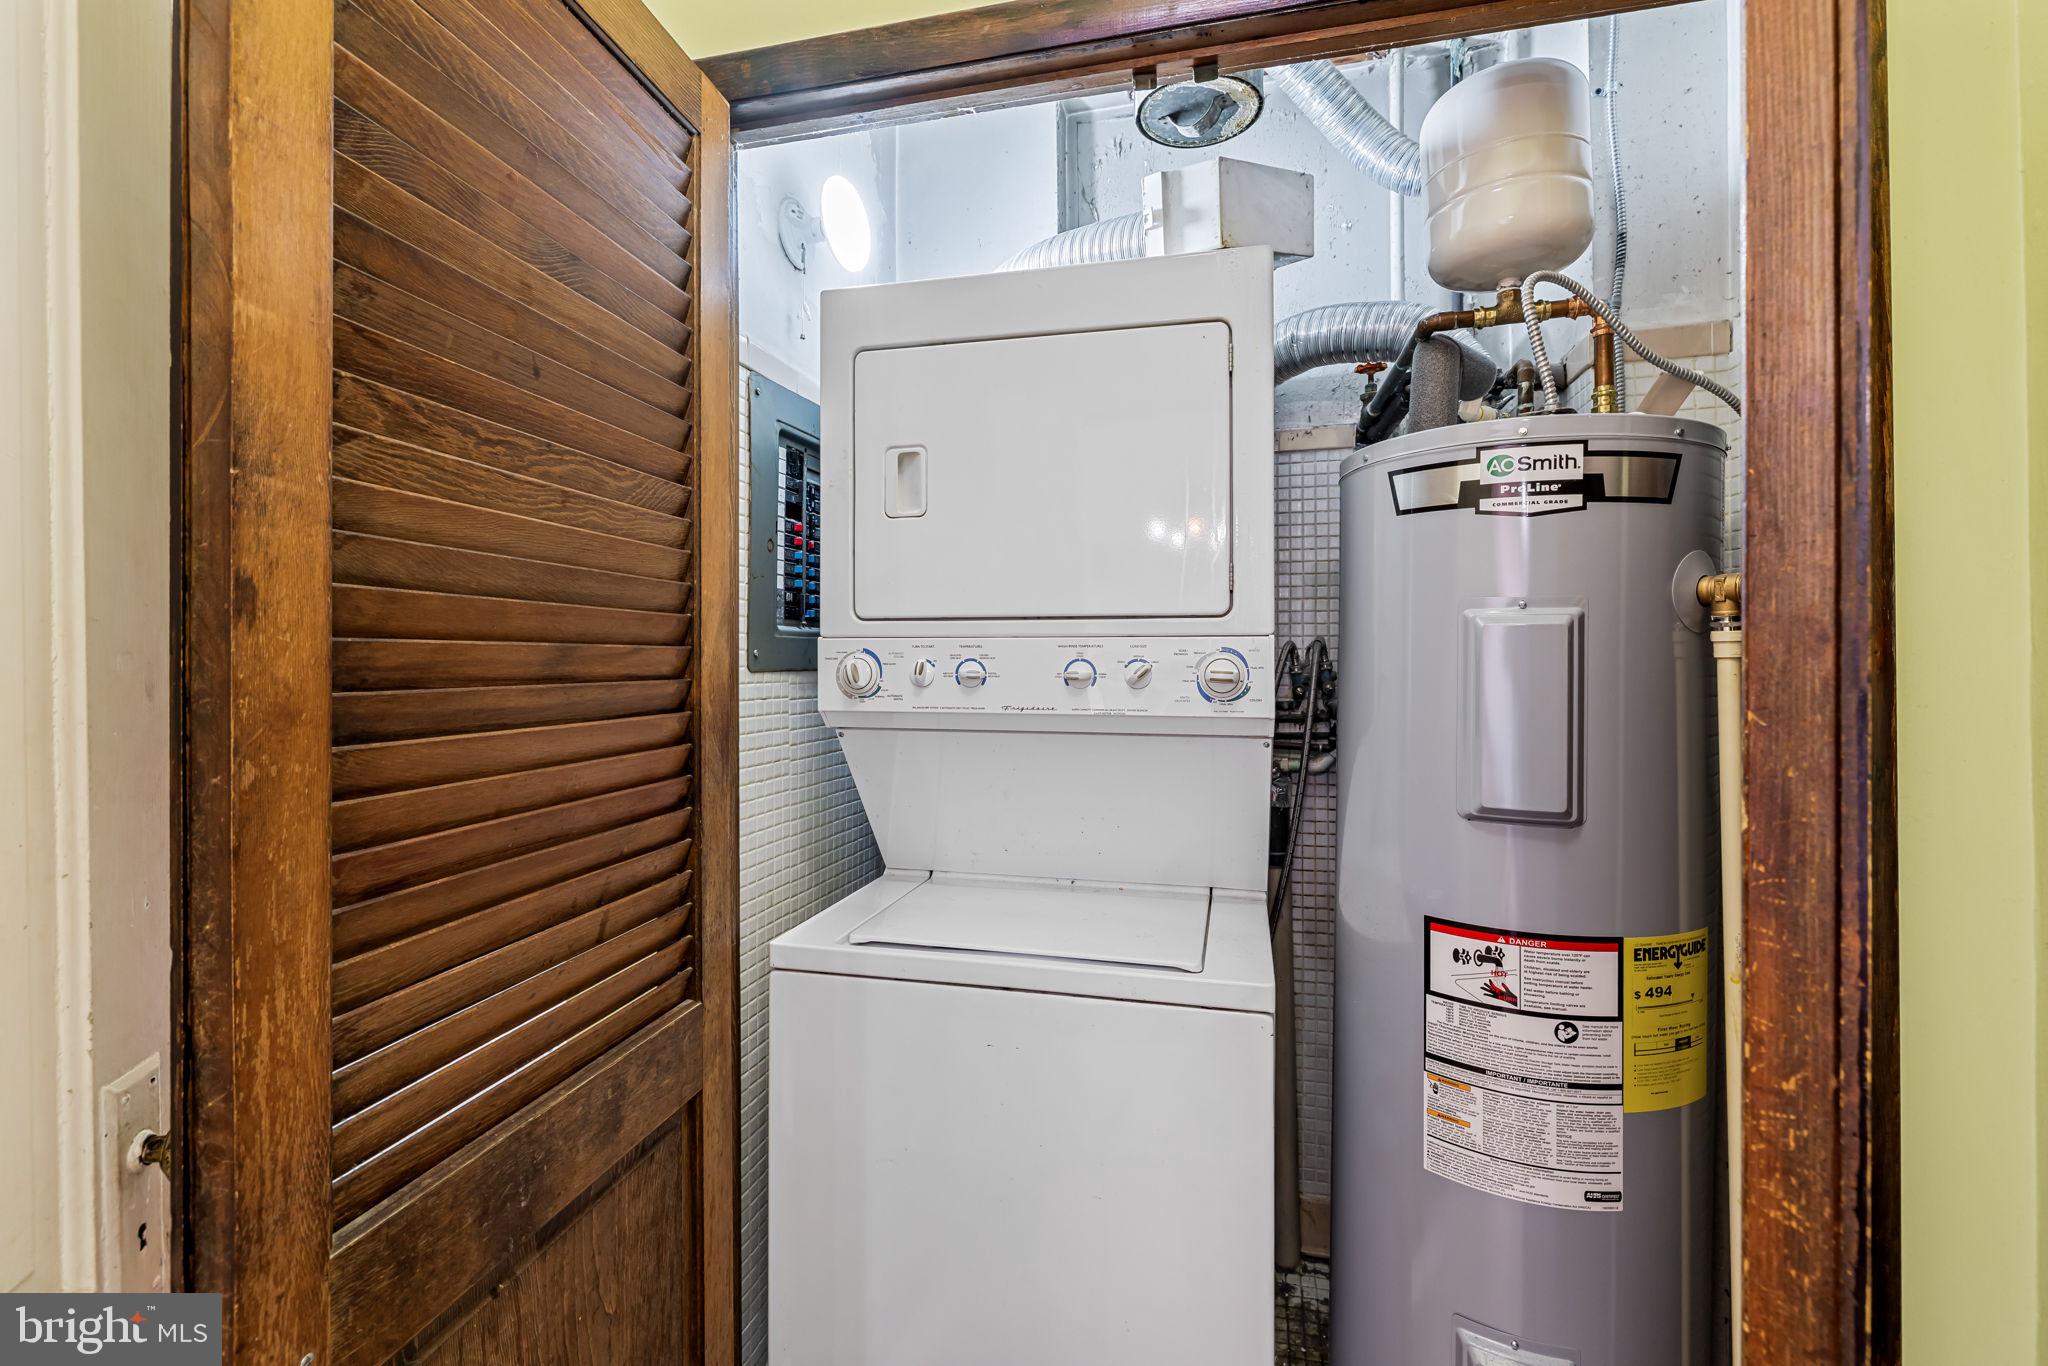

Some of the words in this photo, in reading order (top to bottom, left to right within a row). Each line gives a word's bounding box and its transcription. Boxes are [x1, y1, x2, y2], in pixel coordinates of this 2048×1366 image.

[1509, 937, 1546, 948] DANGER
[1634, 938, 1706, 963] ENERGYGUIDE
[1634, 991, 1641, 1000] $
[1645, 985, 1672, 998] 494
[1486, 1070, 1522, 1082] IMPORTANT
[1527, 1079, 1568, 1088] IMPORTANTE
